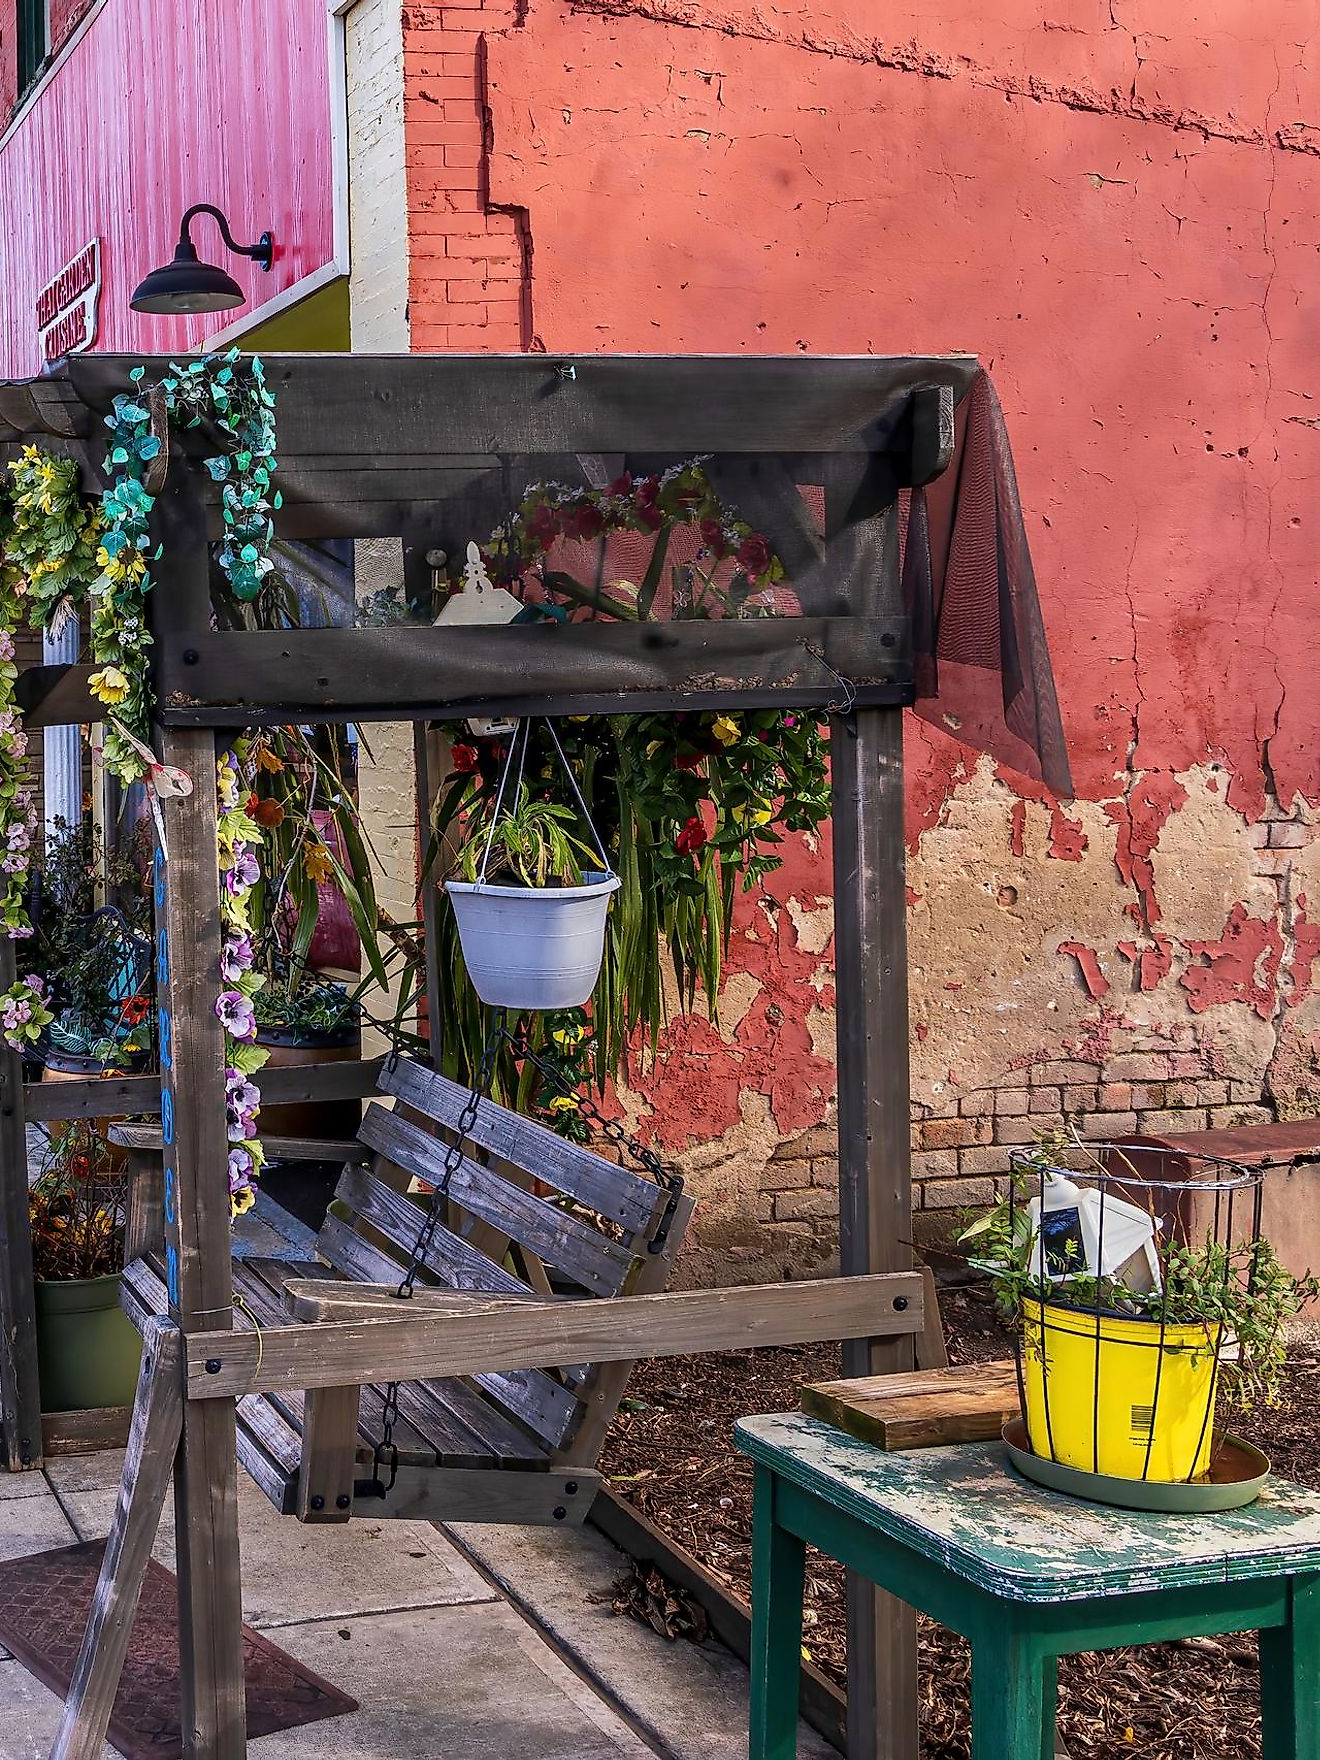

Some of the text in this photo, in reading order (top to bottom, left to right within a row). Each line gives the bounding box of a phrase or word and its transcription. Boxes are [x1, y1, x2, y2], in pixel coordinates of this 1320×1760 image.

[36, 244, 96, 332] THAI GARDEN
[45, 301, 86, 361] CUISINE
